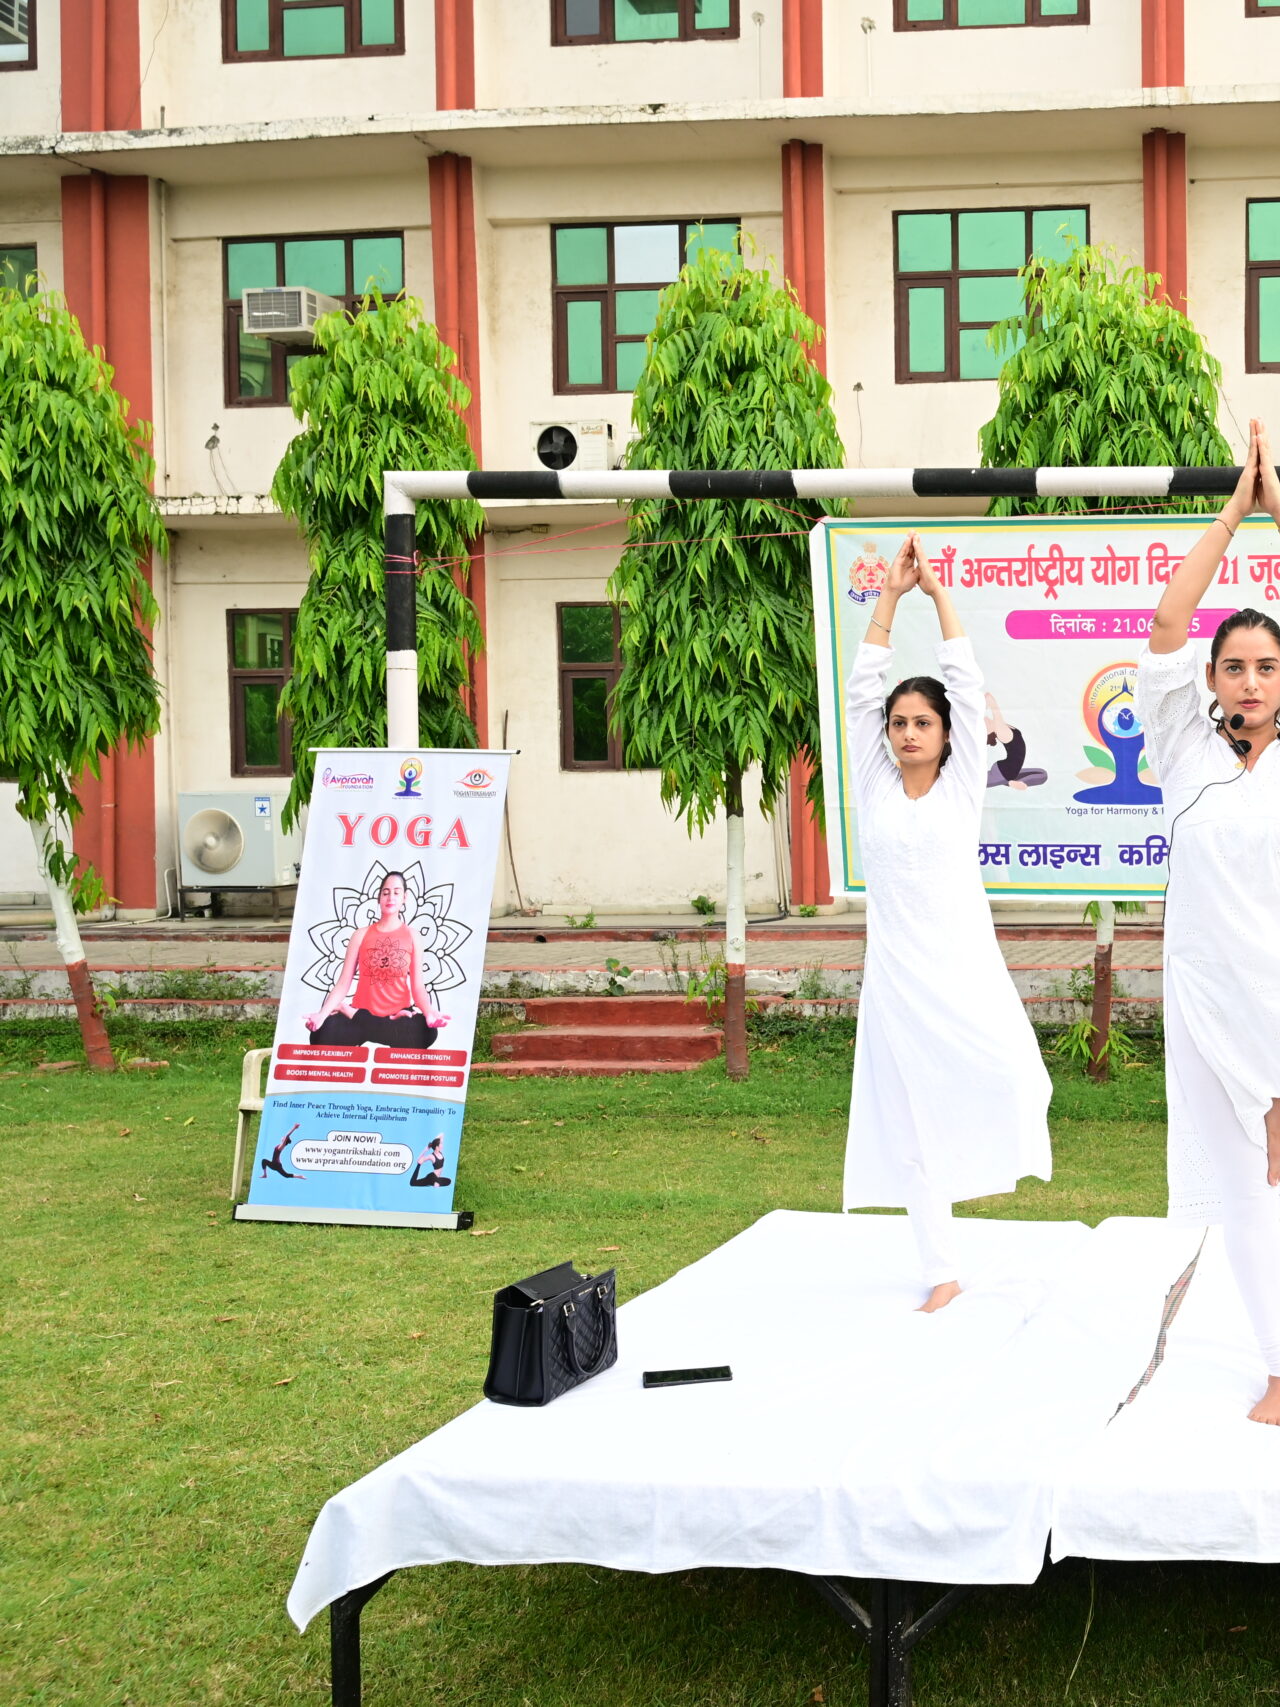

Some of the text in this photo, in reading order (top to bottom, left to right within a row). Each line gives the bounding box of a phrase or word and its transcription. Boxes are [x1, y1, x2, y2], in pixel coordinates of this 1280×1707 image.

[960, 543, 1084, 600] अन्तर्राष्ट्रीय
[1091, 544, 1140, 586] योग
[1217, 554, 1239, 584] 21
[1049, 613, 1096, 635] दिनांक
[1090, 668, 1127, 709] International
[1065, 806, 1089, 817] Yoga
[1090, 807, 1104, 815] for
[1106, 806, 1149, 817] Harmony
[1152, 807, 1158, 815] &
[336, 813, 471, 849] YOGA
[1017, 844, 1101, 869] लाइन्स
[321, 1049, 353, 1057] FLEXIBILITY
[422, 1053, 451, 1061] STRENGTH
[272, 1100, 288, 1108] Find
[289, 1101, 306, 1109] Inner
[328, 1102, 355, 1112] Through
[375, 1104, 410, 1115] Embracing
[412, 1106, 445, 1116] Tranquility
[316, 1111, 407, 1122] Achieve Internal Equilibrium
[332, 1134, 377, 1143] JOIN NOW!
[305, 1146, 401, 1157] wwwyogantrikshakticom
[295, 1156, 407, 1170] wwwavpravahfoundationorg
